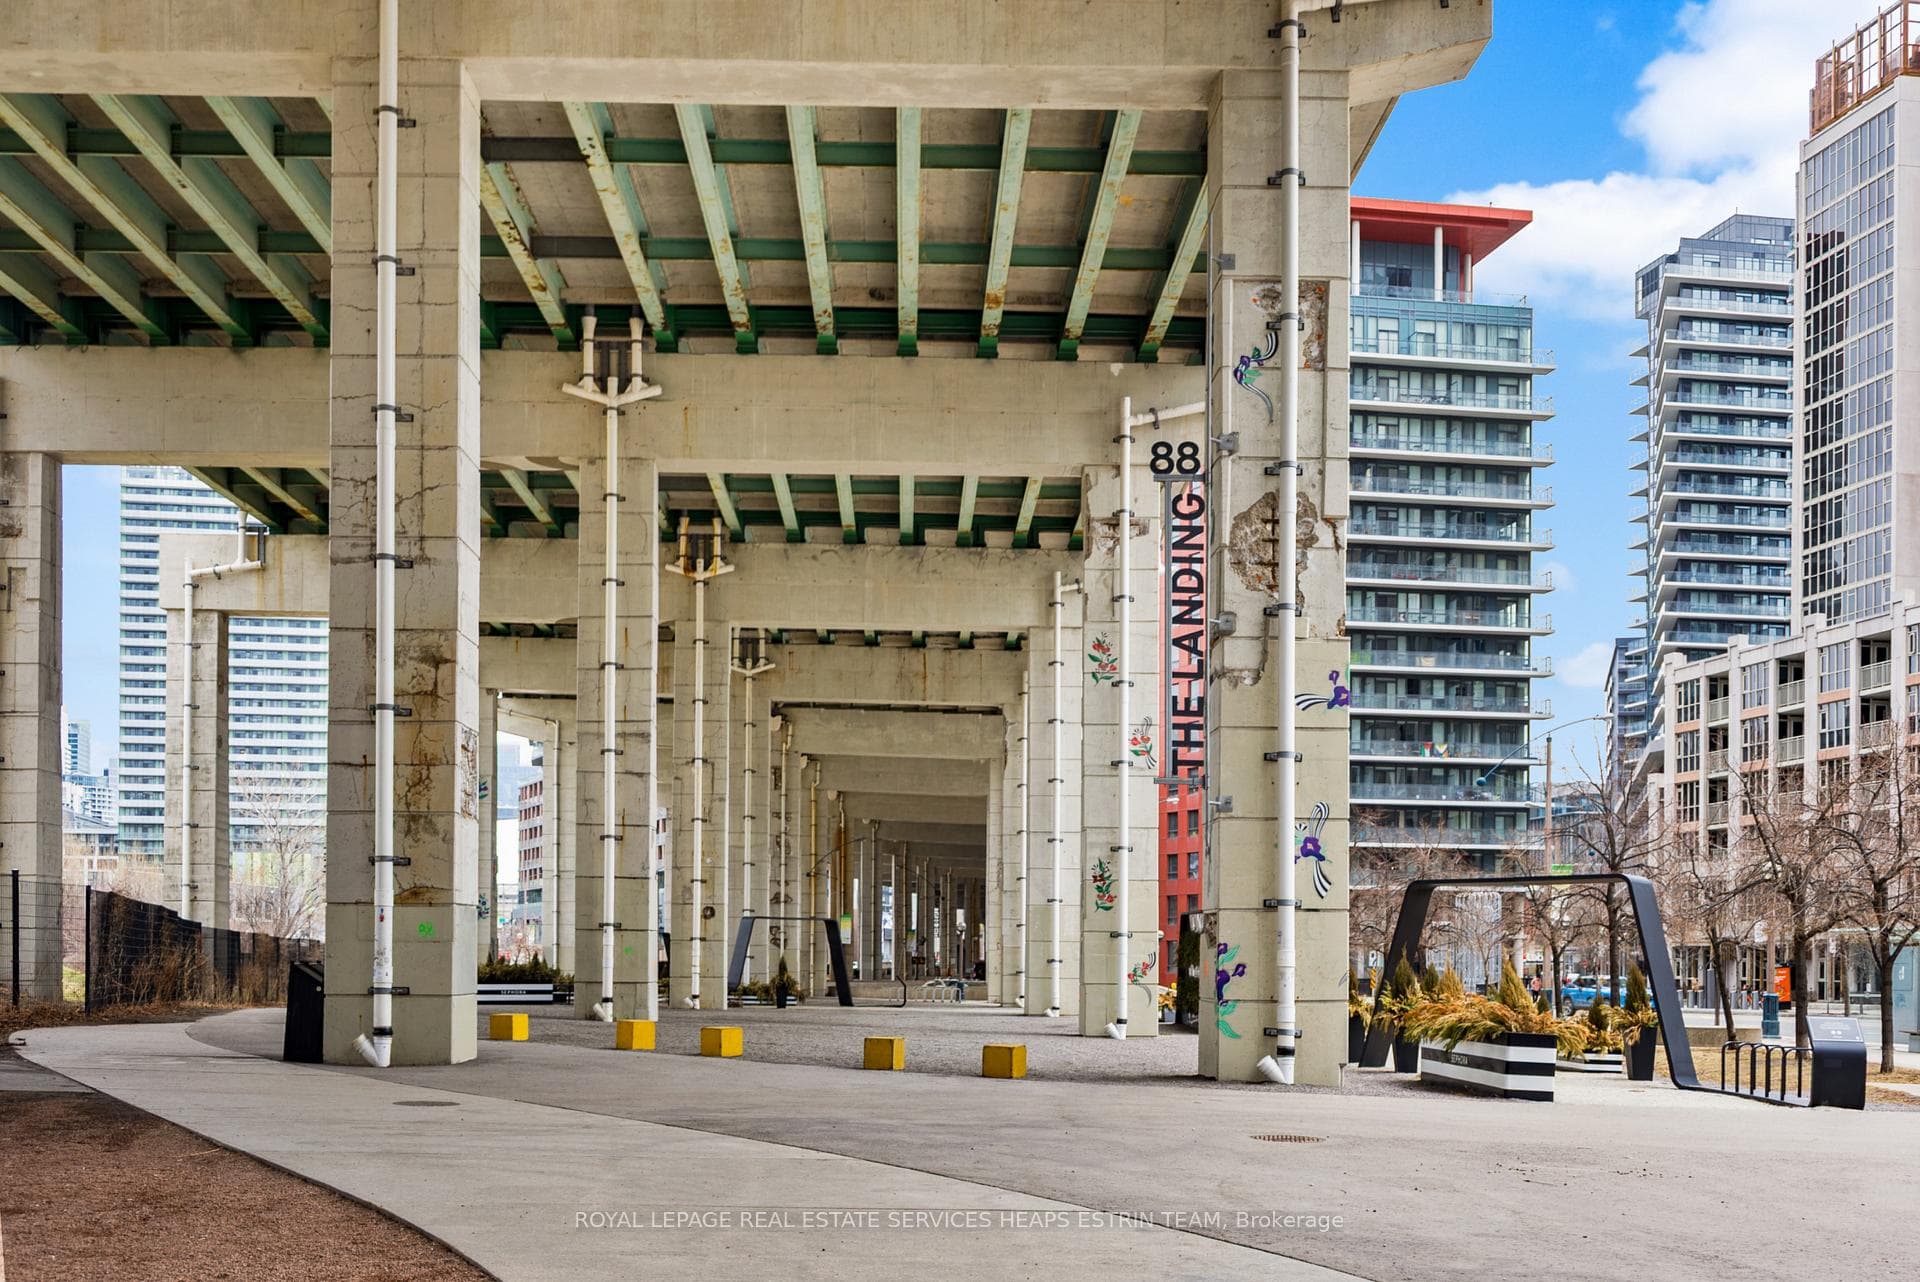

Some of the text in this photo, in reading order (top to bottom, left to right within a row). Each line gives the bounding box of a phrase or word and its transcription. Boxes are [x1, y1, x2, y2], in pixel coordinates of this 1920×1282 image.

[1148, 440, 1201, 475] 88
[1171, 492, 1206, 776] THE LANDING
